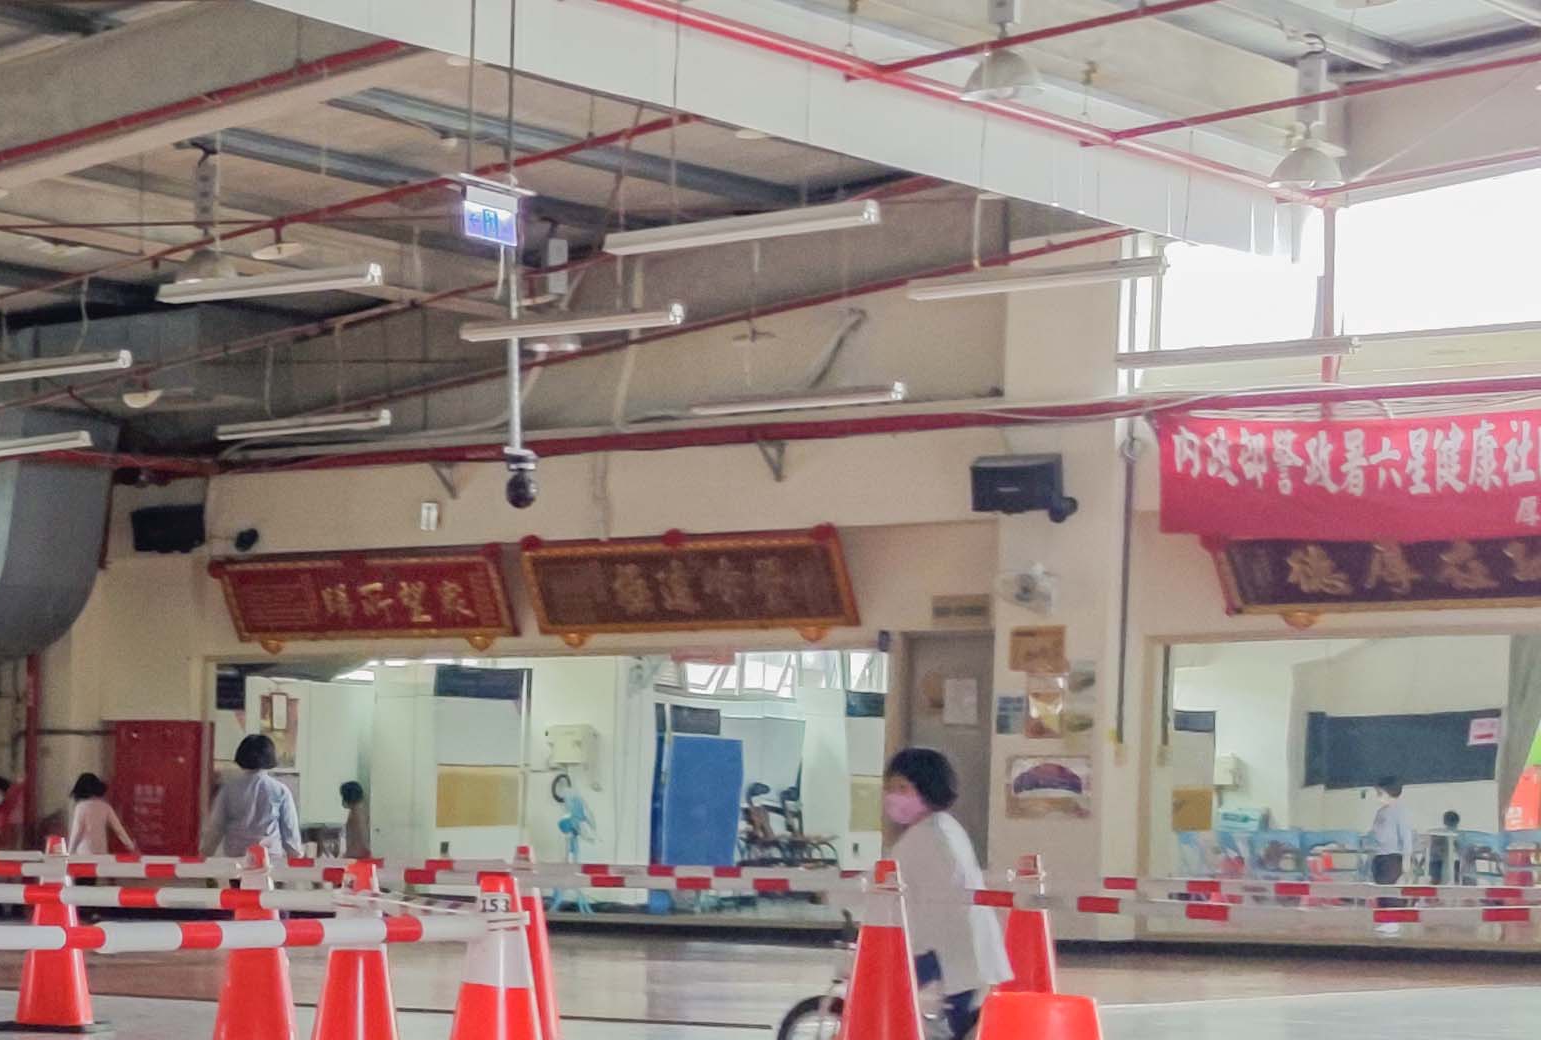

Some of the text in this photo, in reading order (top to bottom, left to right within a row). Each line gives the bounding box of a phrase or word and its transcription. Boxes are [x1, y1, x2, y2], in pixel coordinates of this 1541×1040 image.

[1171, 419, 1541, 496] 內政部警政署六星健康社
